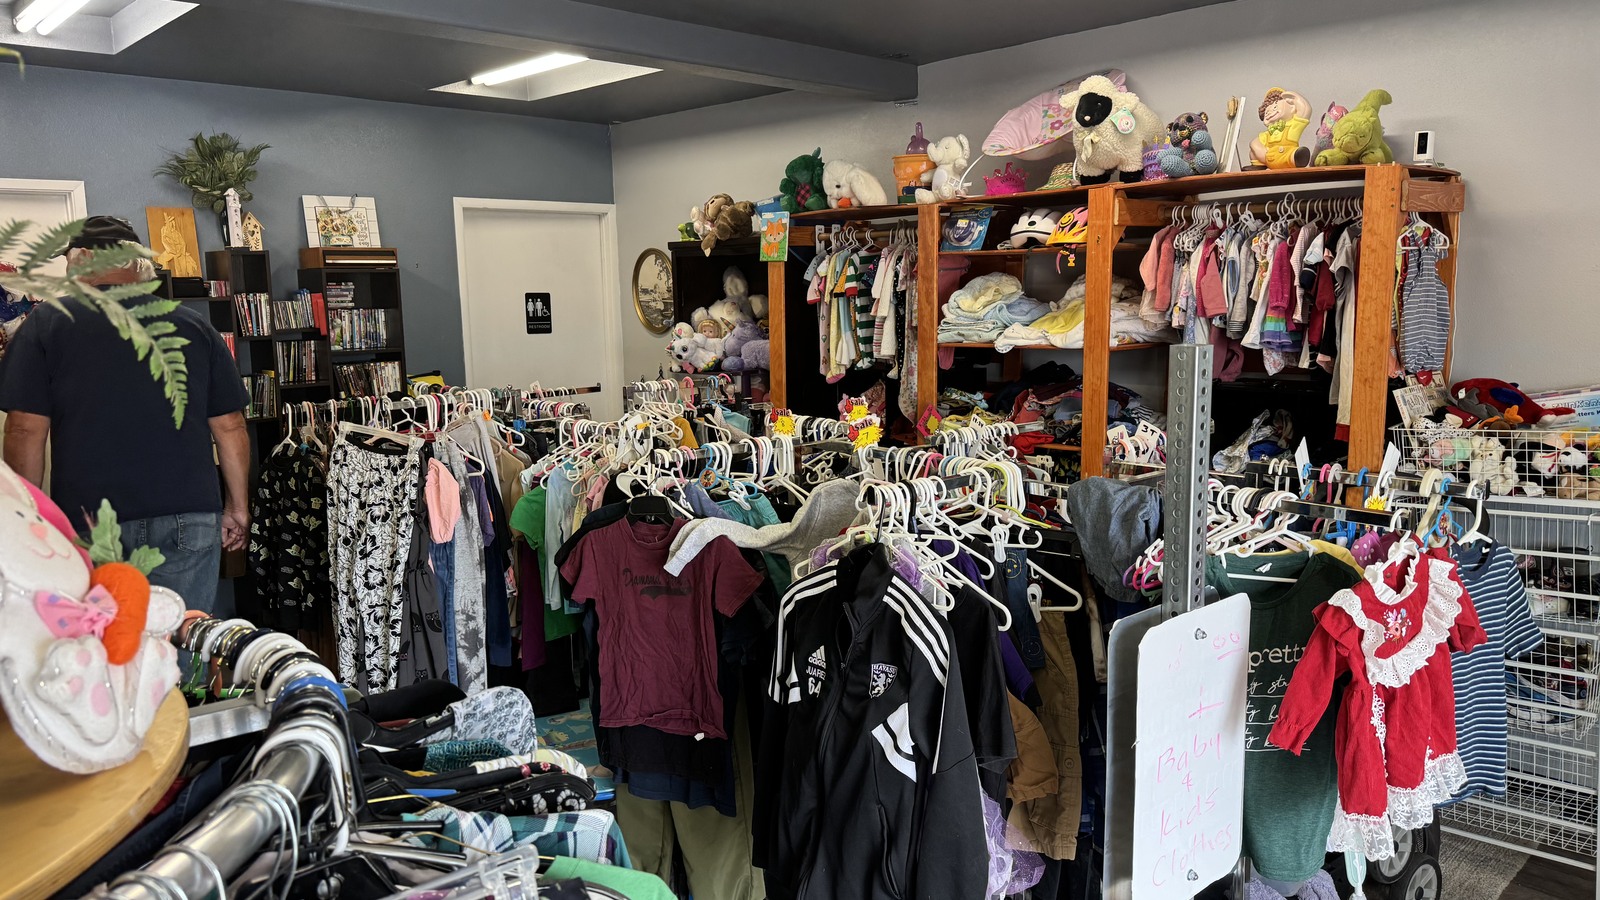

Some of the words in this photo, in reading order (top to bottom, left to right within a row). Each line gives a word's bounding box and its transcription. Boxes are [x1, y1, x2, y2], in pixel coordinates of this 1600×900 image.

[775, 409, 790, 417] sale
[854, 418, 873, 430] sale
[1141, 424, 1157, 436] 3T
[1247, 643, 1307, 673] prett
[808, 677, 822, 698] 64
[1157, 732, 1222, 783] Baby
